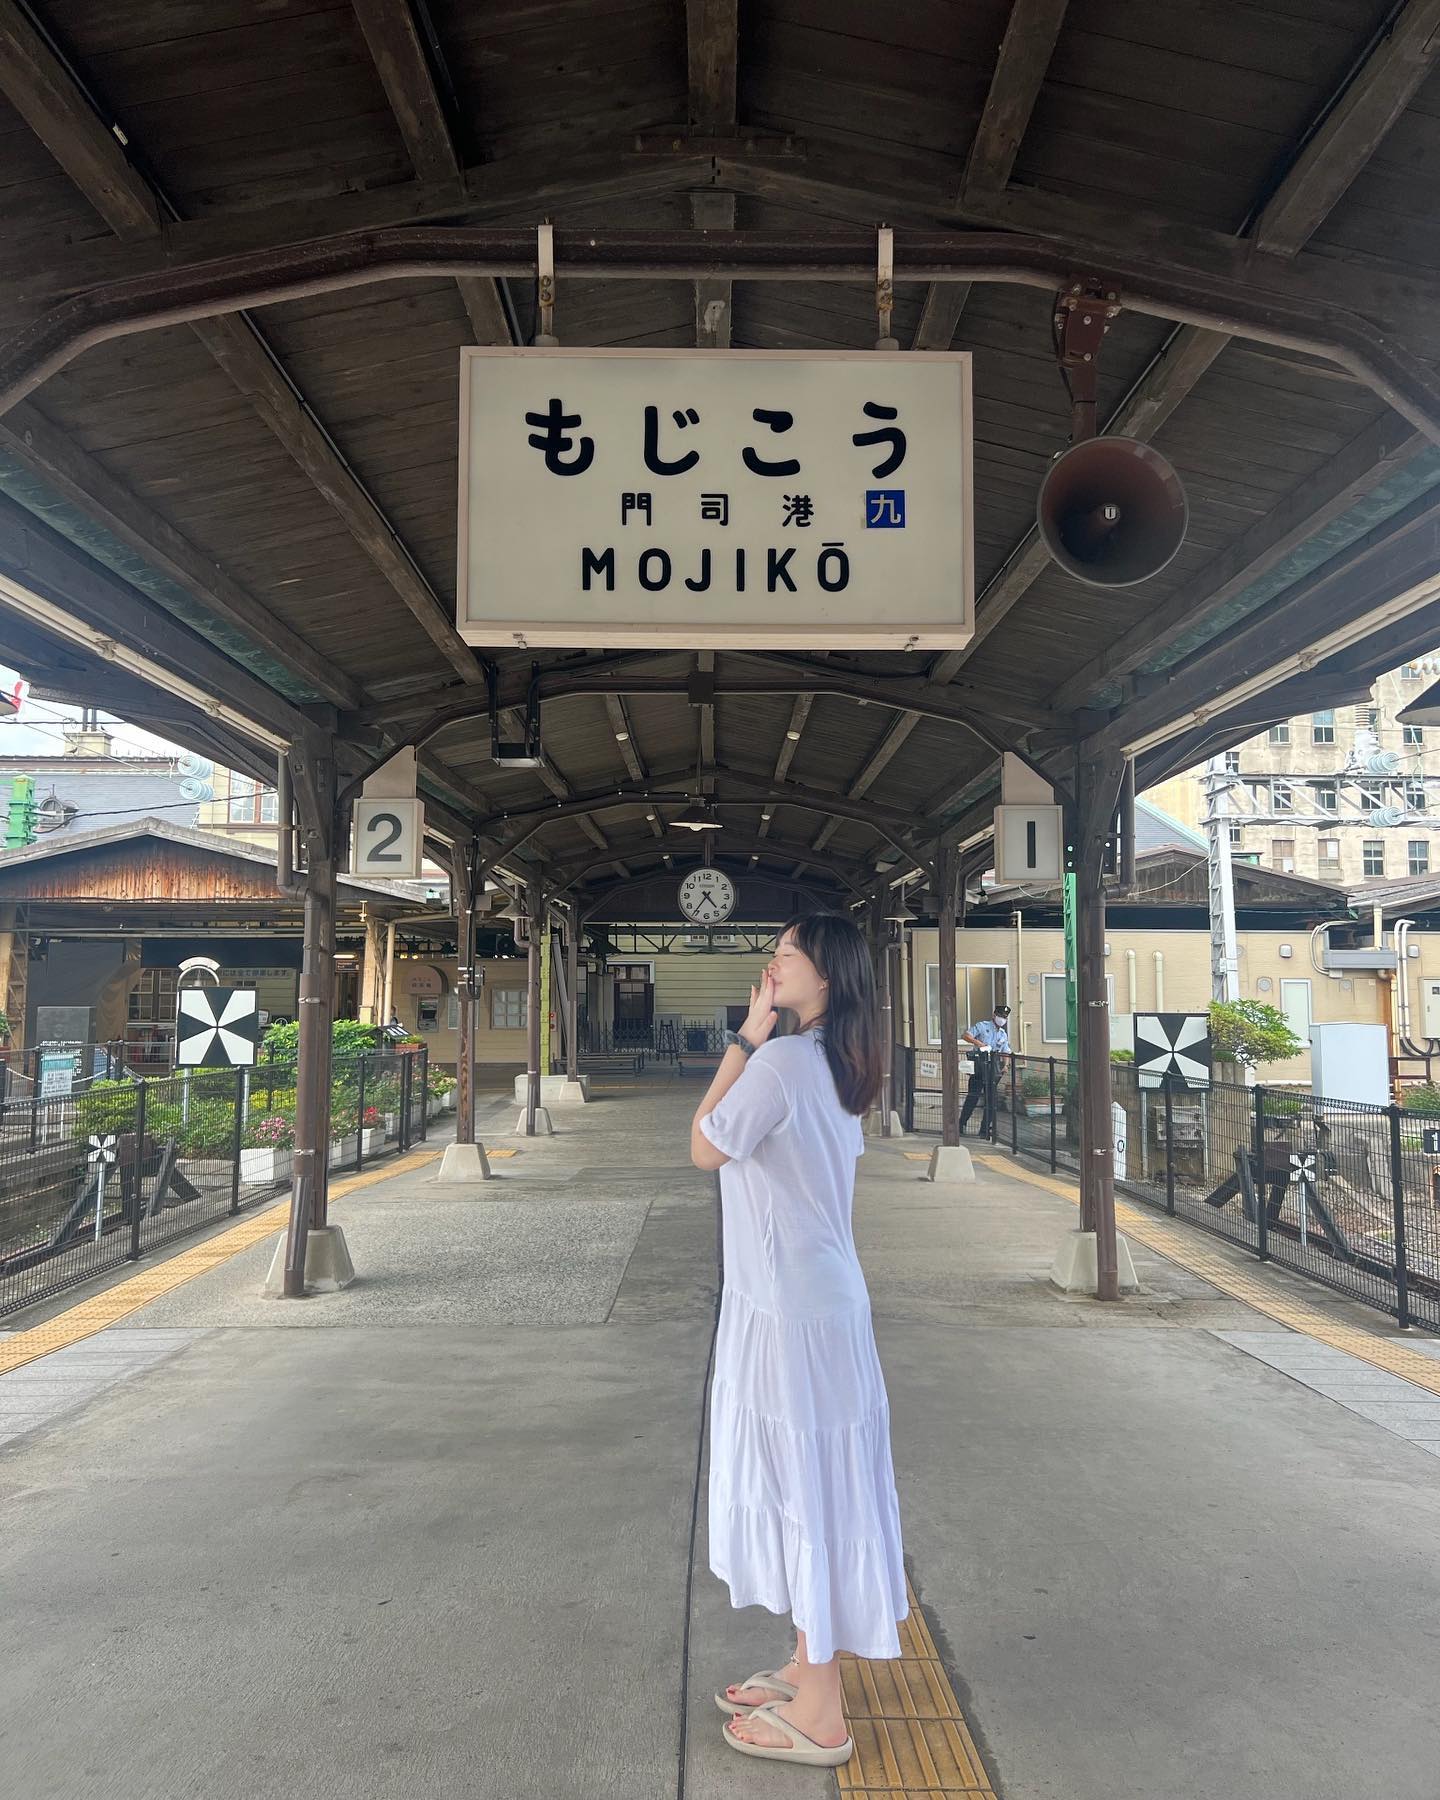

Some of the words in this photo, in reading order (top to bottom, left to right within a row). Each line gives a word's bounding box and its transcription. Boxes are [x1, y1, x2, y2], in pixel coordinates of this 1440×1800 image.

[525, 399, 906, 479] もじこう
[622, 493, 814, 527] 門司港
[871, 494, 901, 525] 九
[582, 543, 849, 592] MOJIKŌ
[367, 813, 402, 862] 2
